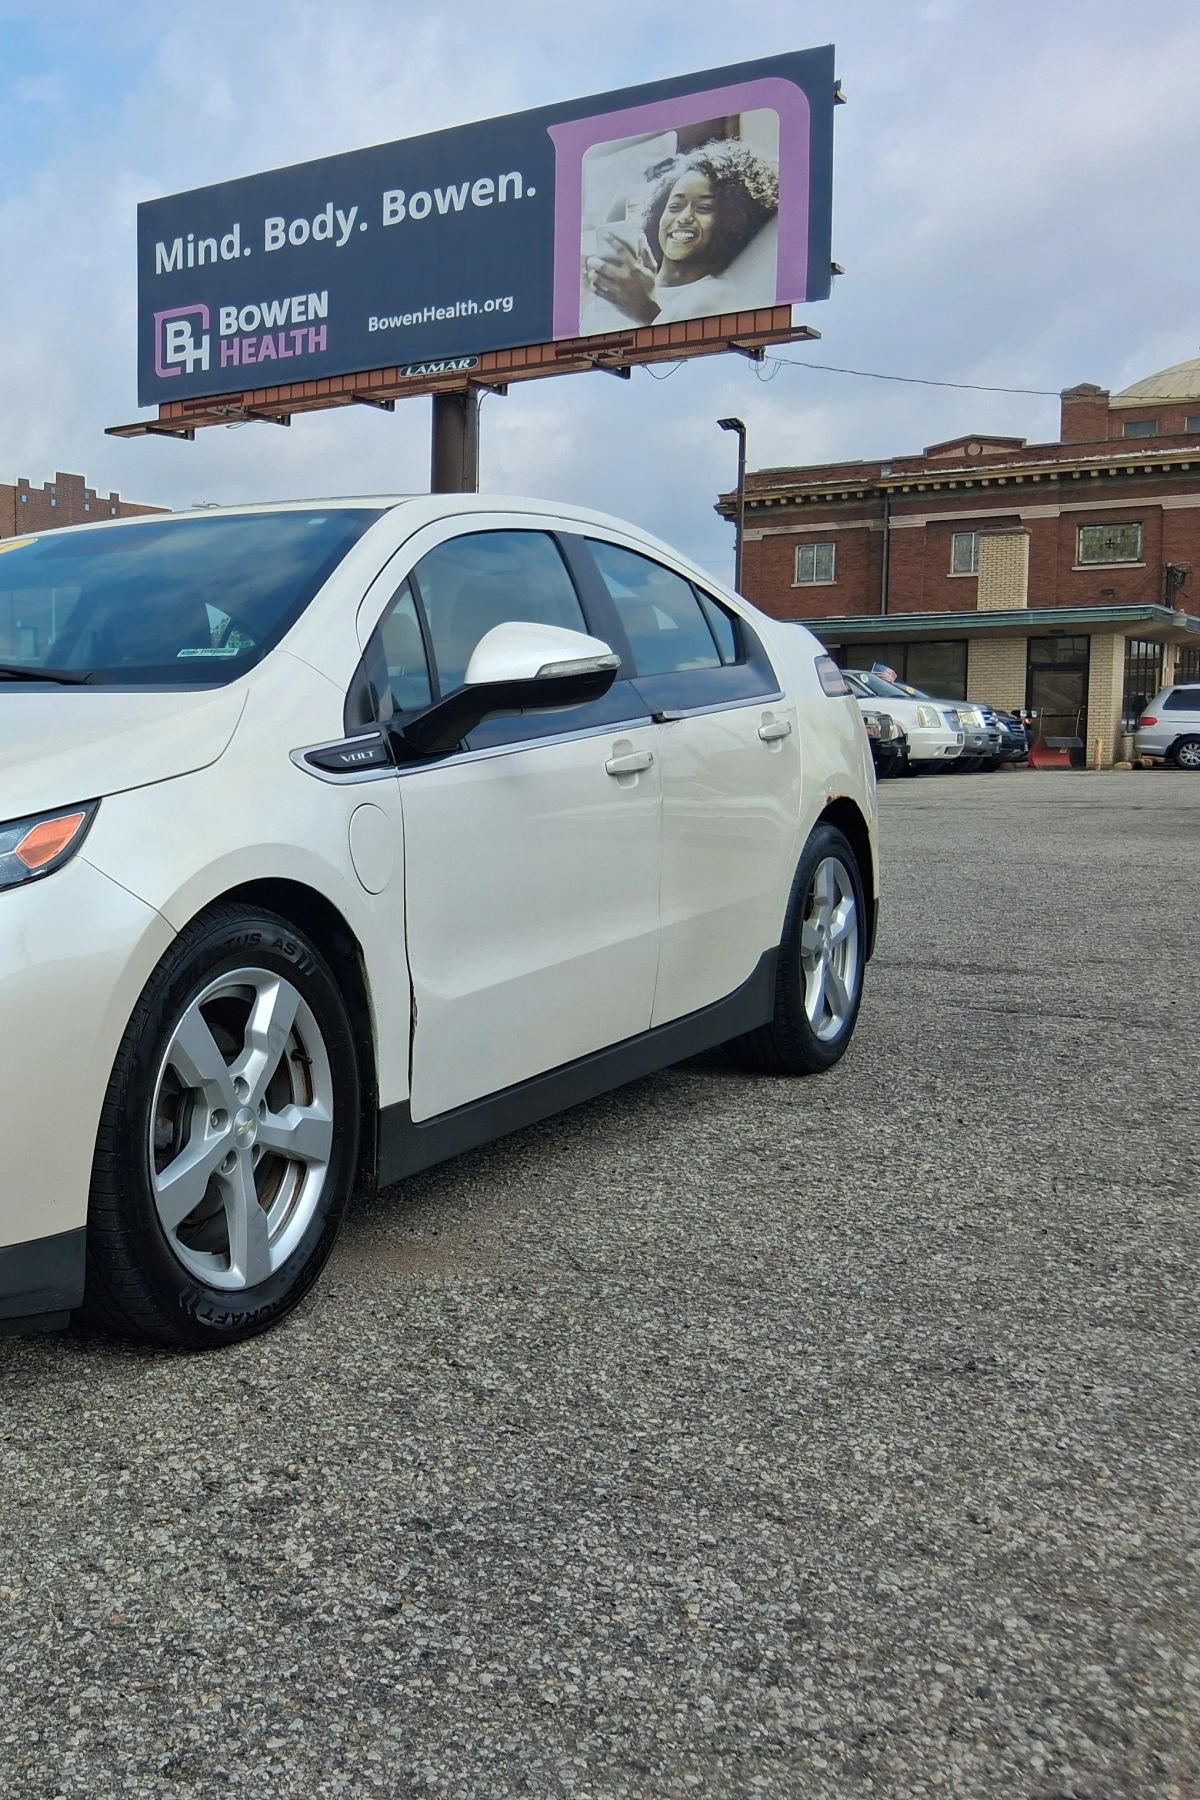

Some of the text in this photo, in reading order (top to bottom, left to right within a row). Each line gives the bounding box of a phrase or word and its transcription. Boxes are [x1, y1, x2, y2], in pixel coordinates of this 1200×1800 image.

[155, 170, 537, 275] Mind. Body. Bowen.
[219, 290, 329, 336] BOWEN
[367, 295, 514, 332] BowenHealth.org
[220, 324, 327, 368] HEALTH
[405, 359, 471, 376] LAMAR
[341, 751, 375, 762] VOLT
